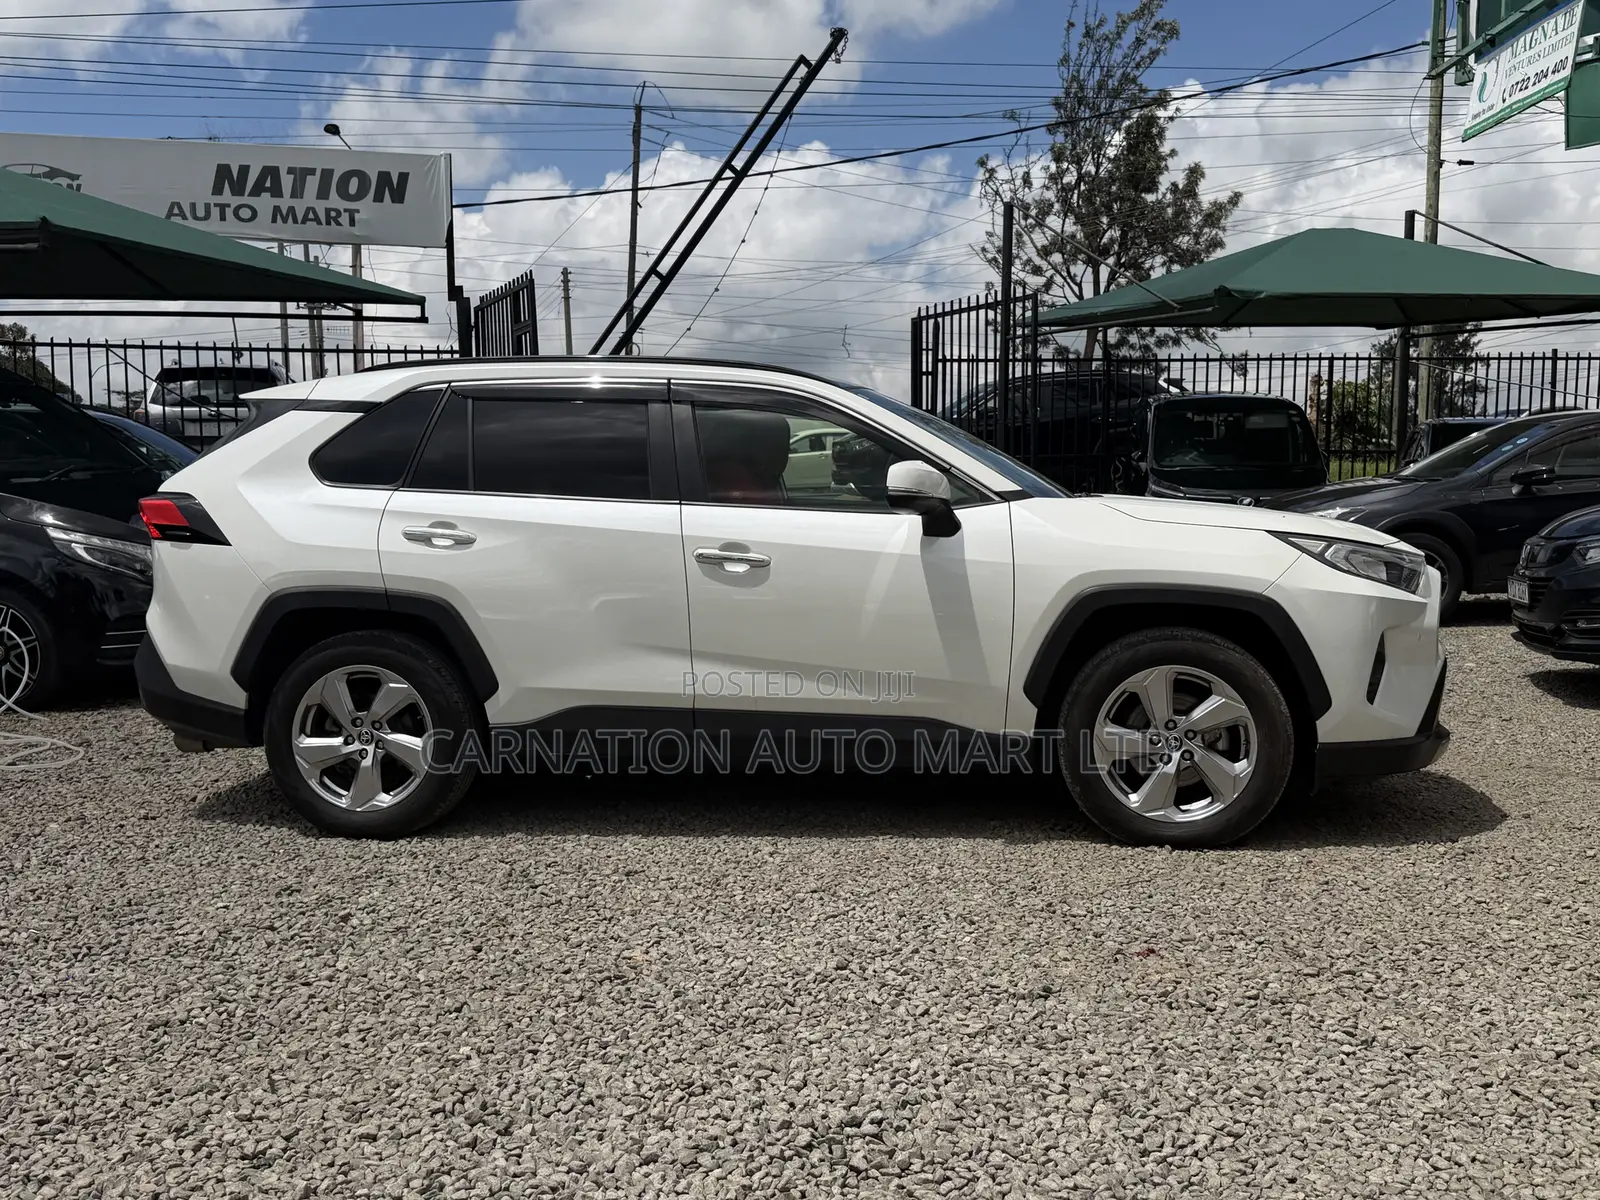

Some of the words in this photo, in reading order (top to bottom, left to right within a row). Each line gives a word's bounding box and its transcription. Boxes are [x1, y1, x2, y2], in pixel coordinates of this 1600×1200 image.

[1505, 50, 1541, 79] VENTURES
[1543, 31, 1575, 58] LIMITED
[1508, 5, 1580, 63] MAGNATE
[1509, 75, 1531, 98] 0722
[1532, 65, 1549, 87] 204
[1551, 56, 1569, 76] 400
[211, 163, 410, 204] NATION
[164, 201, 258, 223] AUTO
[271, 205, 360, 227] MART
